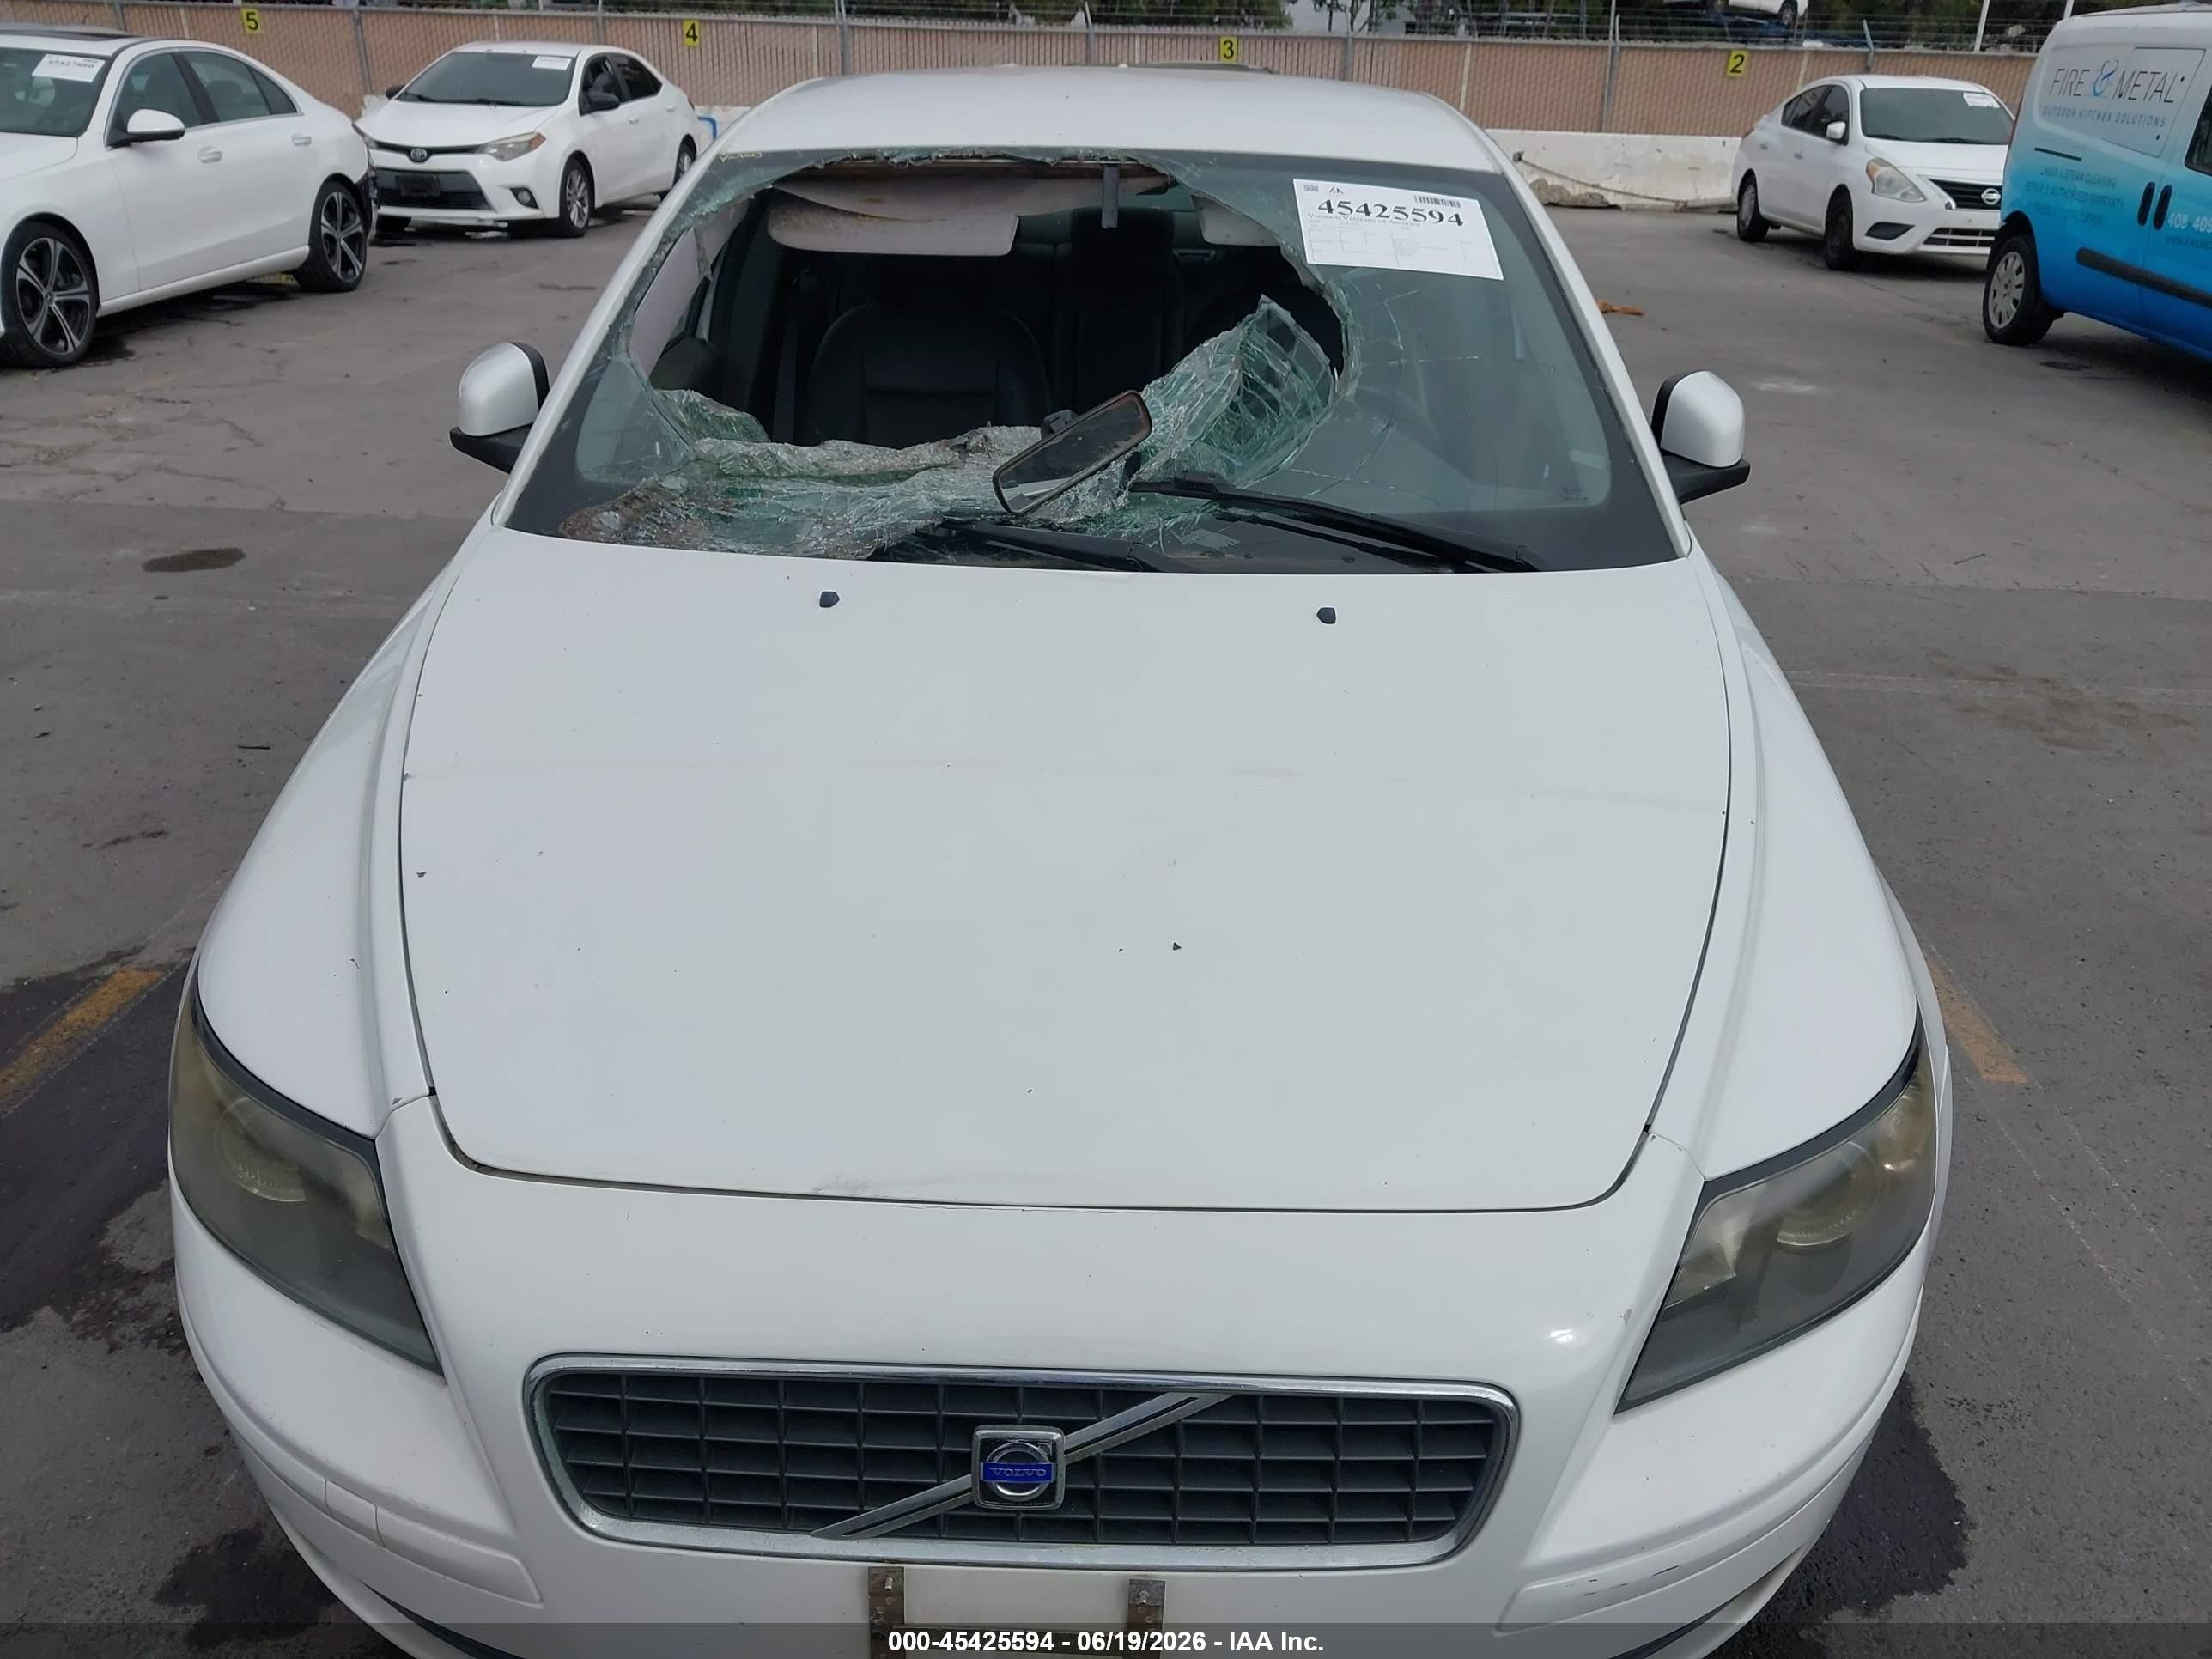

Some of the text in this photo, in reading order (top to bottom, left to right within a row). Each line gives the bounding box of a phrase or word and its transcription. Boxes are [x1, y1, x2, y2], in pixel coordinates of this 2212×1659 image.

[245, 11, 259, 31] 5
[685, 21, 698, 42] 4
[1223, 39, 1235, 60] 3
[1729, 53, 1746, 74] 2
[2049, 68, 2091, 97] FIRE
[2112, 70, 2179, 104] METAL
[2042, 105, 2168, 128] OUTDOOR KITCHEN SOLUTIONS
[1317, 198, 1464, 227] 45425594
[2167, 212, 2189, 230] 408
[988, 1468, 1046, 1477] VOLVO
